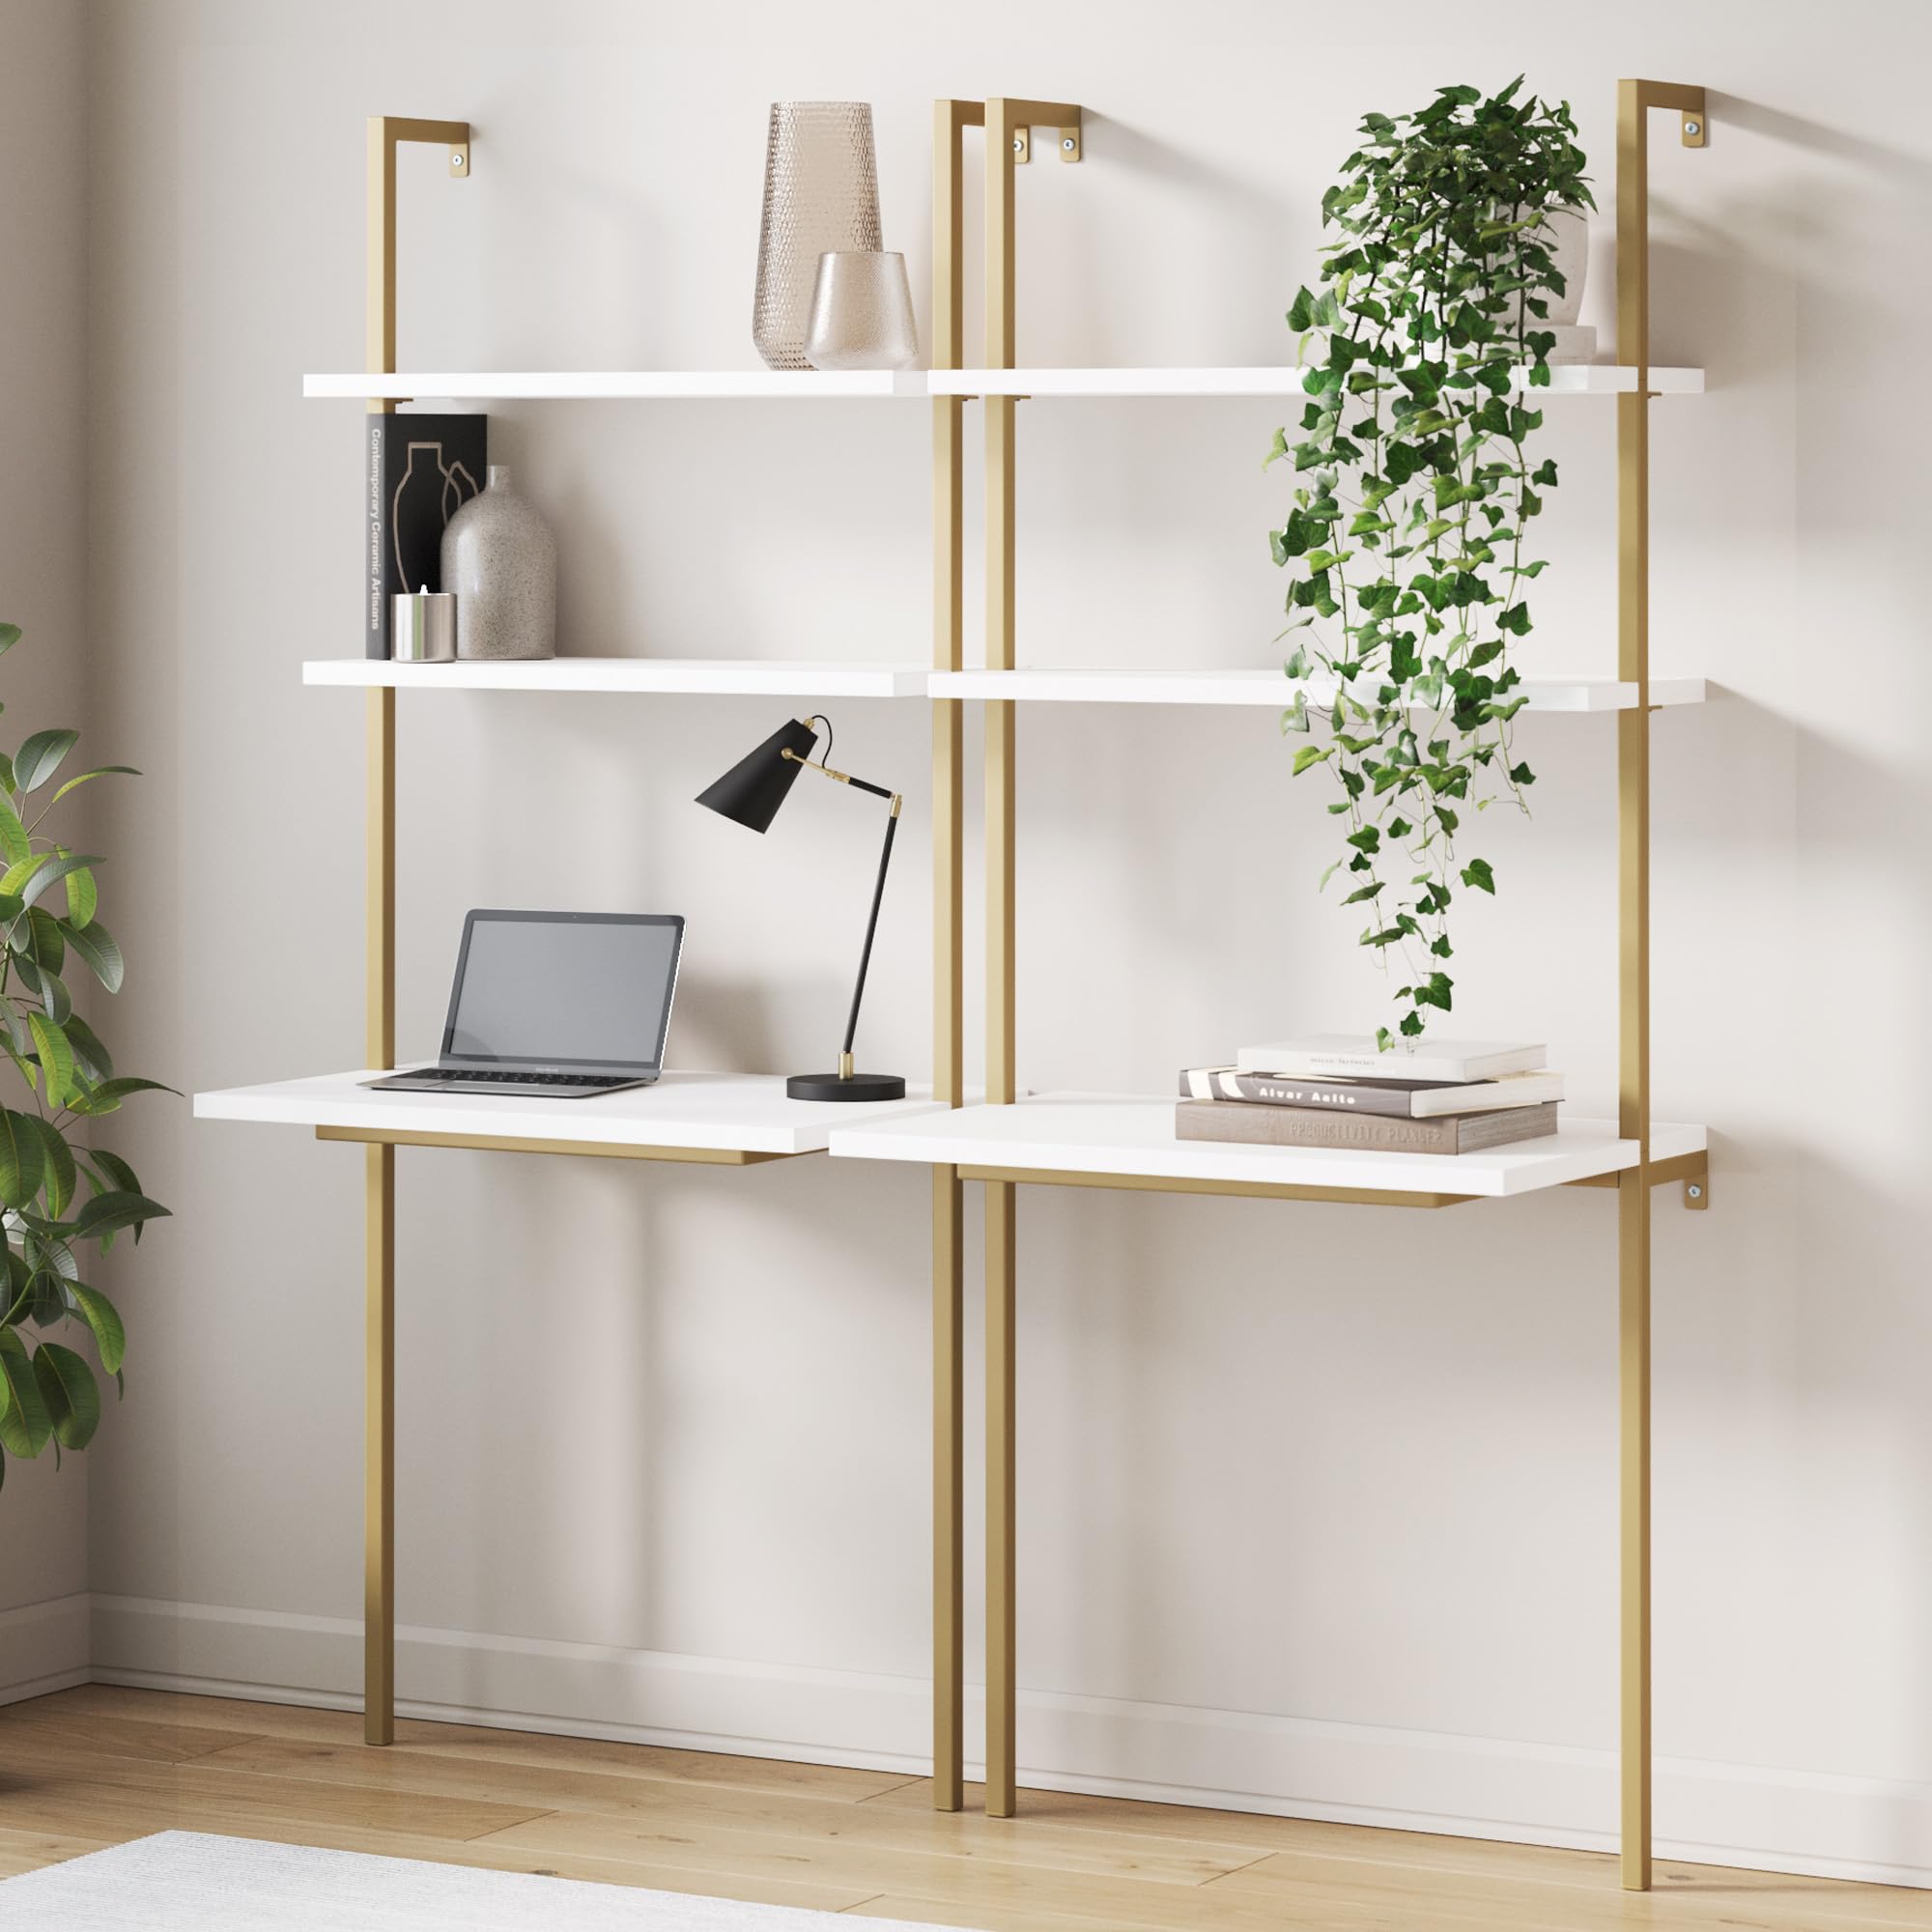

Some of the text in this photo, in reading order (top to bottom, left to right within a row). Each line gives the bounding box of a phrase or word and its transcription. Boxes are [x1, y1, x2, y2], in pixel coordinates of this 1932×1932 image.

[370, 428, 382, 630] Contemporary Ceramic Artisans
[1259, 1087, 1355, 1104] Alvar Aalto
